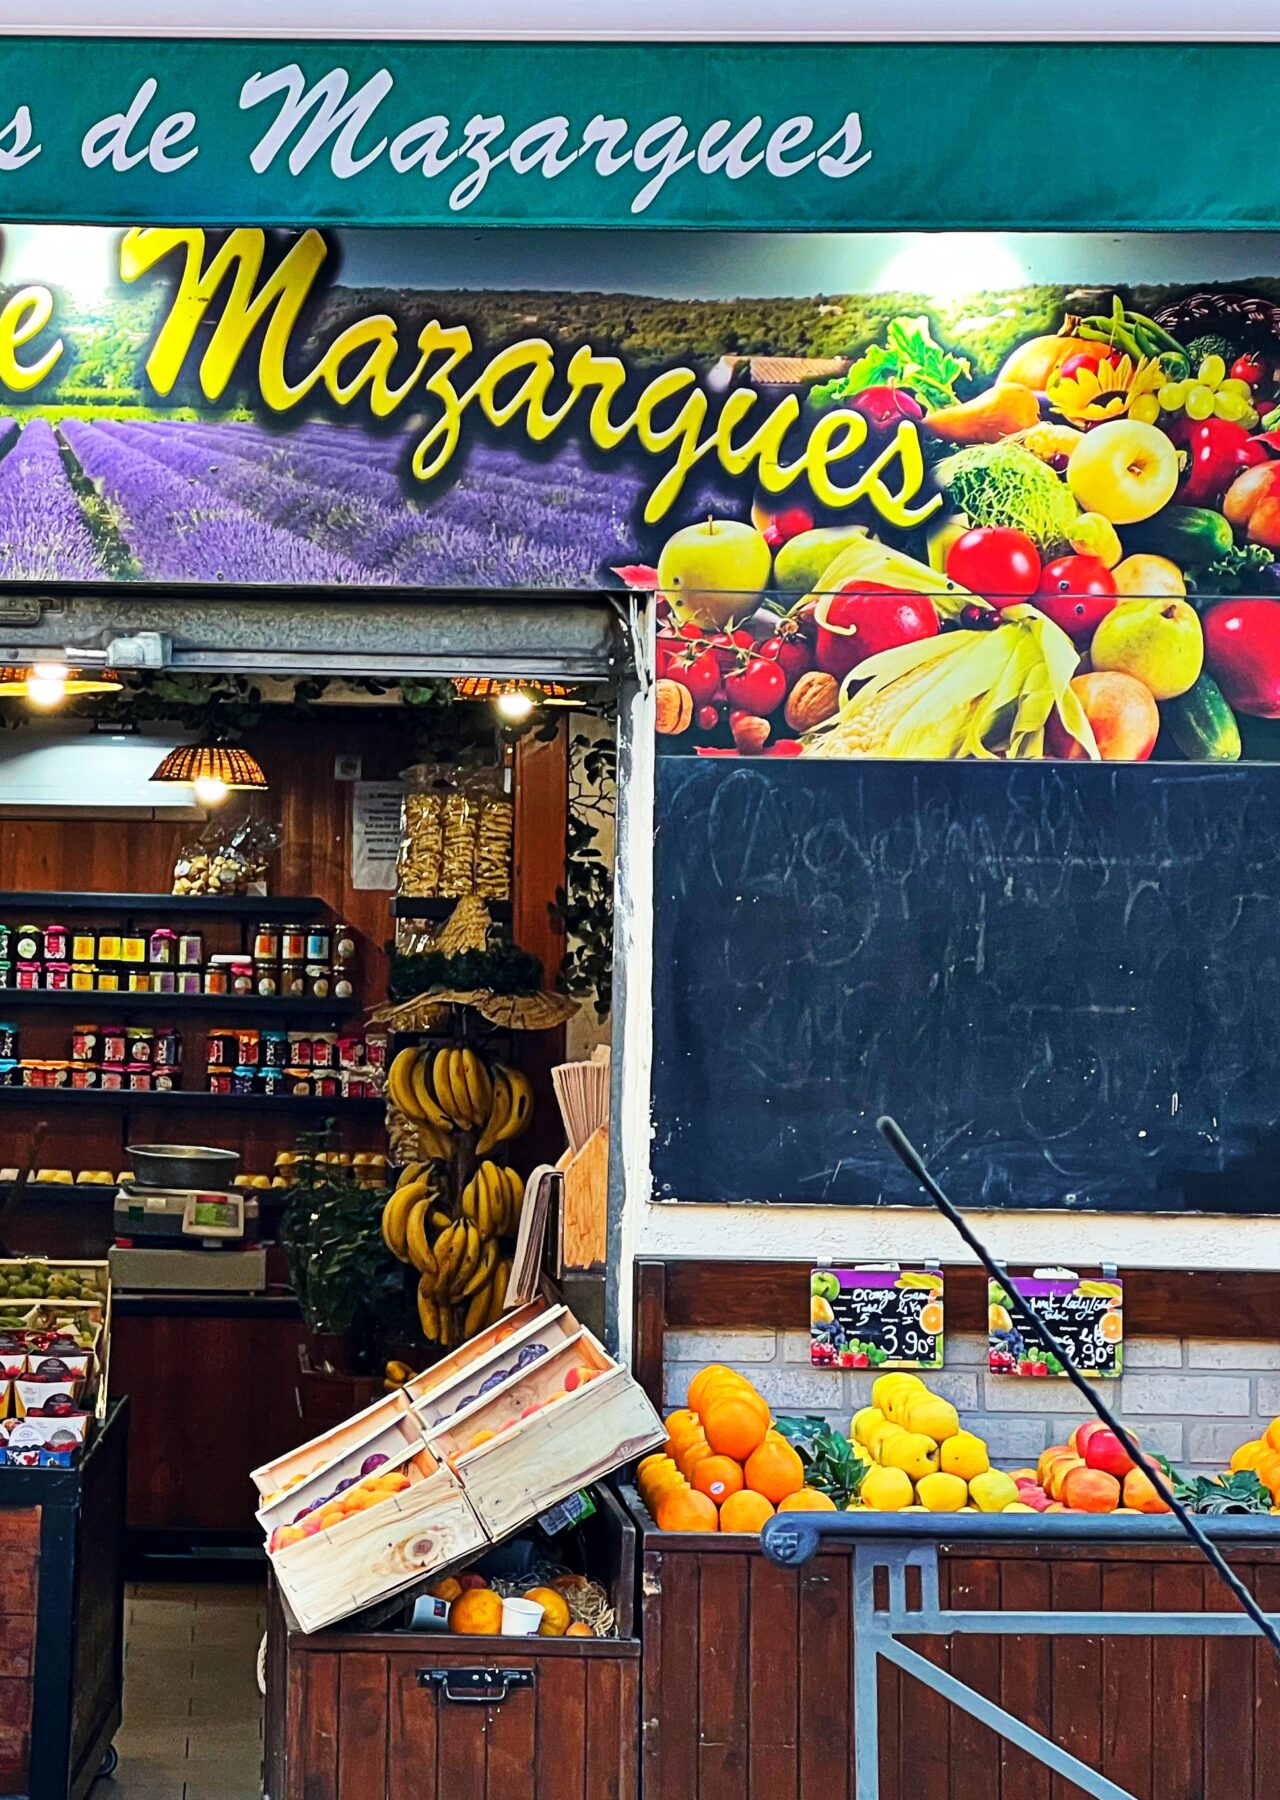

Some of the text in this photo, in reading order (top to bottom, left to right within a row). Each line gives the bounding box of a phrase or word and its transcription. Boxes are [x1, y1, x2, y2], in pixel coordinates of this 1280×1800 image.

[80, 76, 200, 174] de
[238, 62, 874, 213] Mazargues
[119, 226, 944, 529] Mazargues
